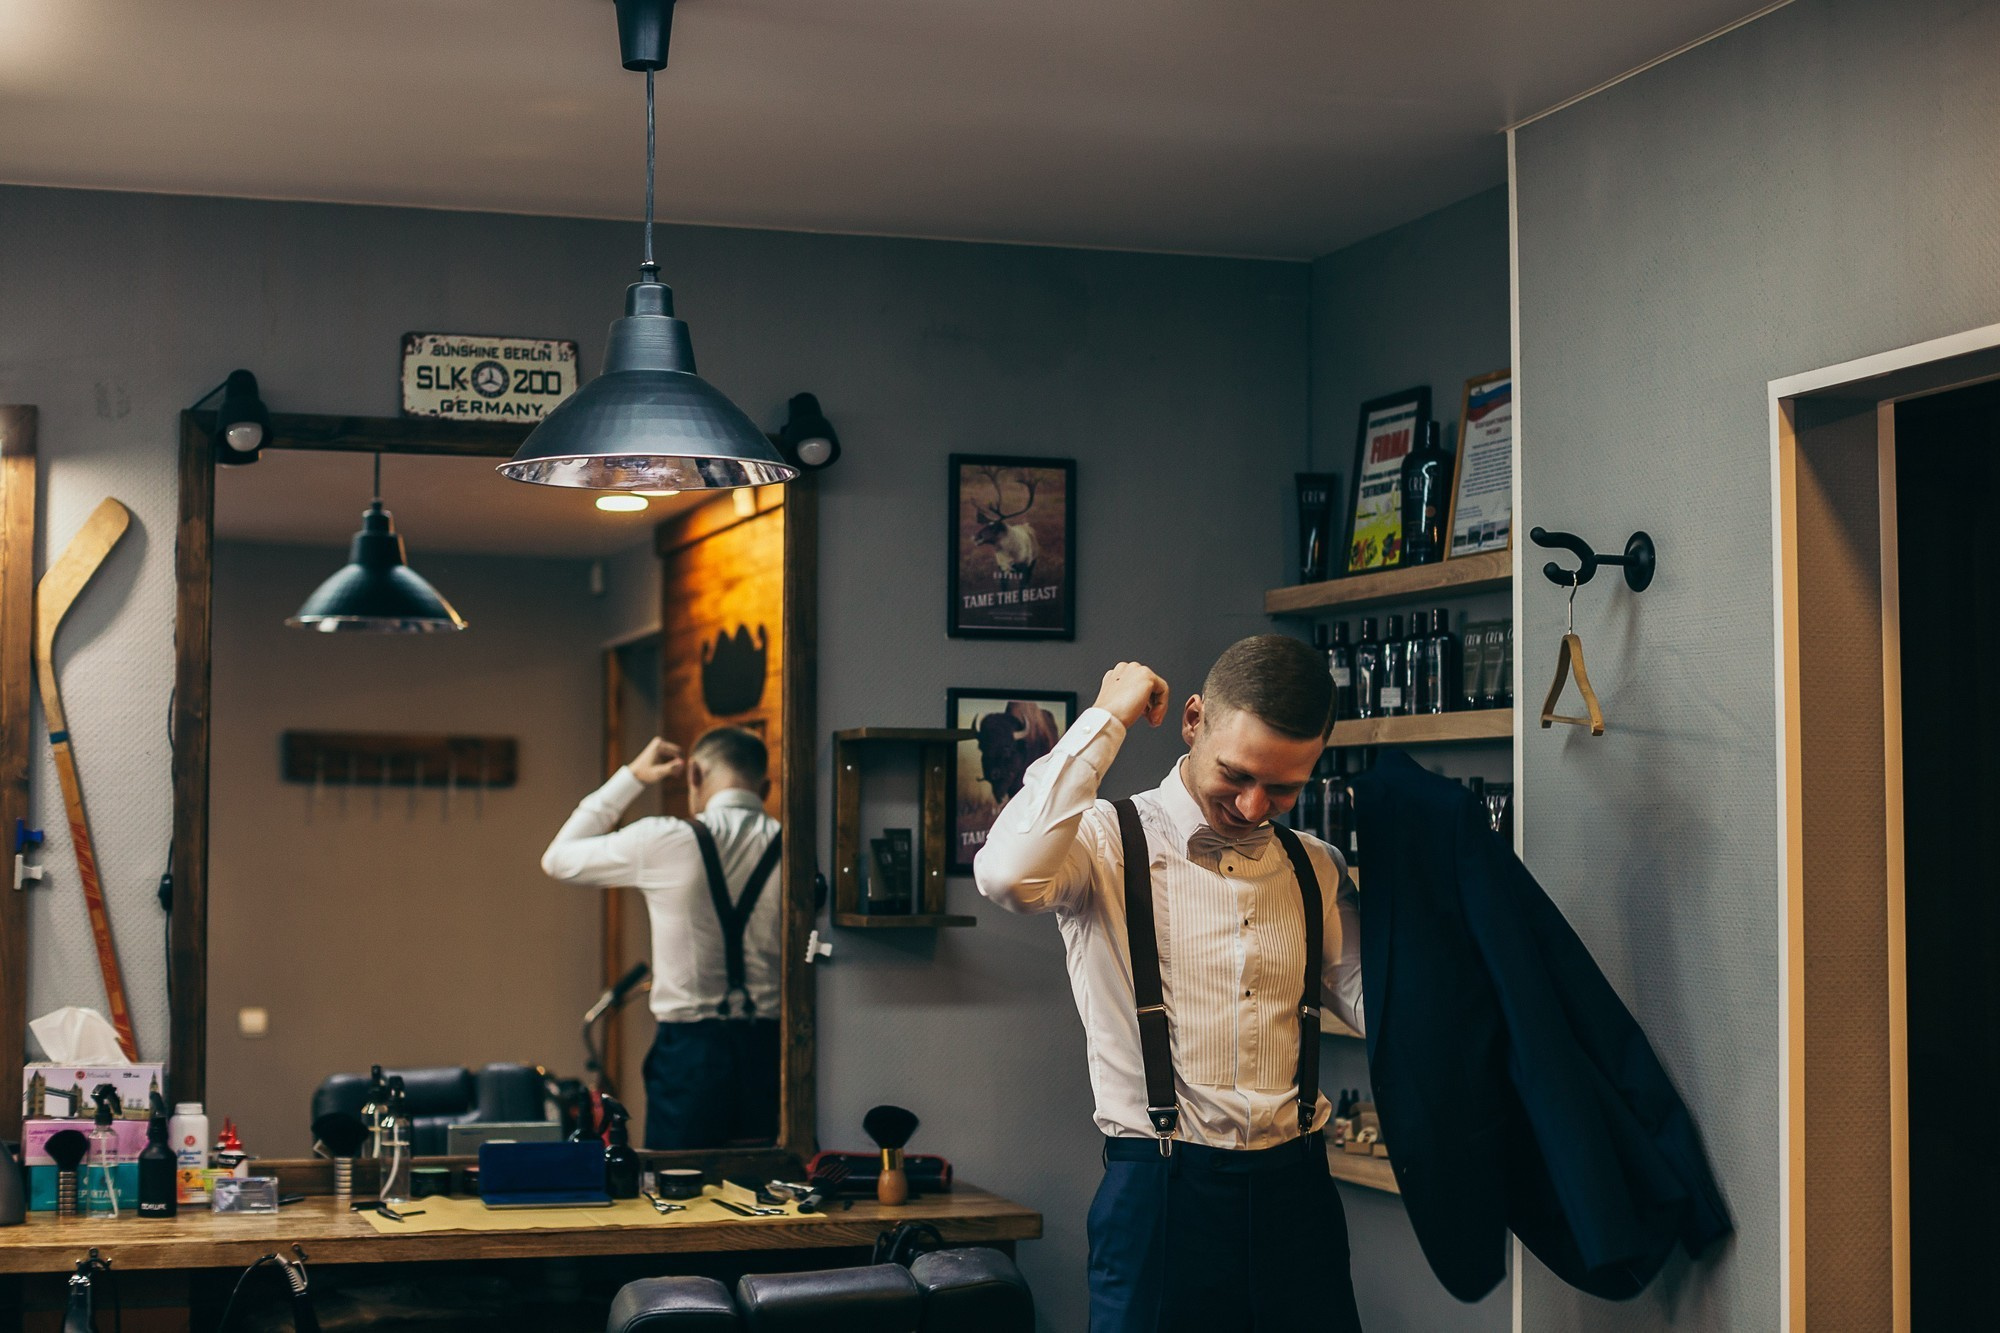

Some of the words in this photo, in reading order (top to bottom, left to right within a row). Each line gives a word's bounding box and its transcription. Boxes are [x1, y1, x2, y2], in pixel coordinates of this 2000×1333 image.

[432, 344, 499, 359] SUNSHINE
[503, 346, 552, 361] BERLIN
[416, 365, 468, 391] SLK
[513, 369, 562, 395] 200
[440, 399, 543, 416] GERMANY
[1302, 490, 1327, 503] CREW
[963, 592, 995, 609] TAME
[997, 590, 1019, 605] THE
[1022, 586, 1058, 602] BEAST
[962, 830, 989, 846] TAM
